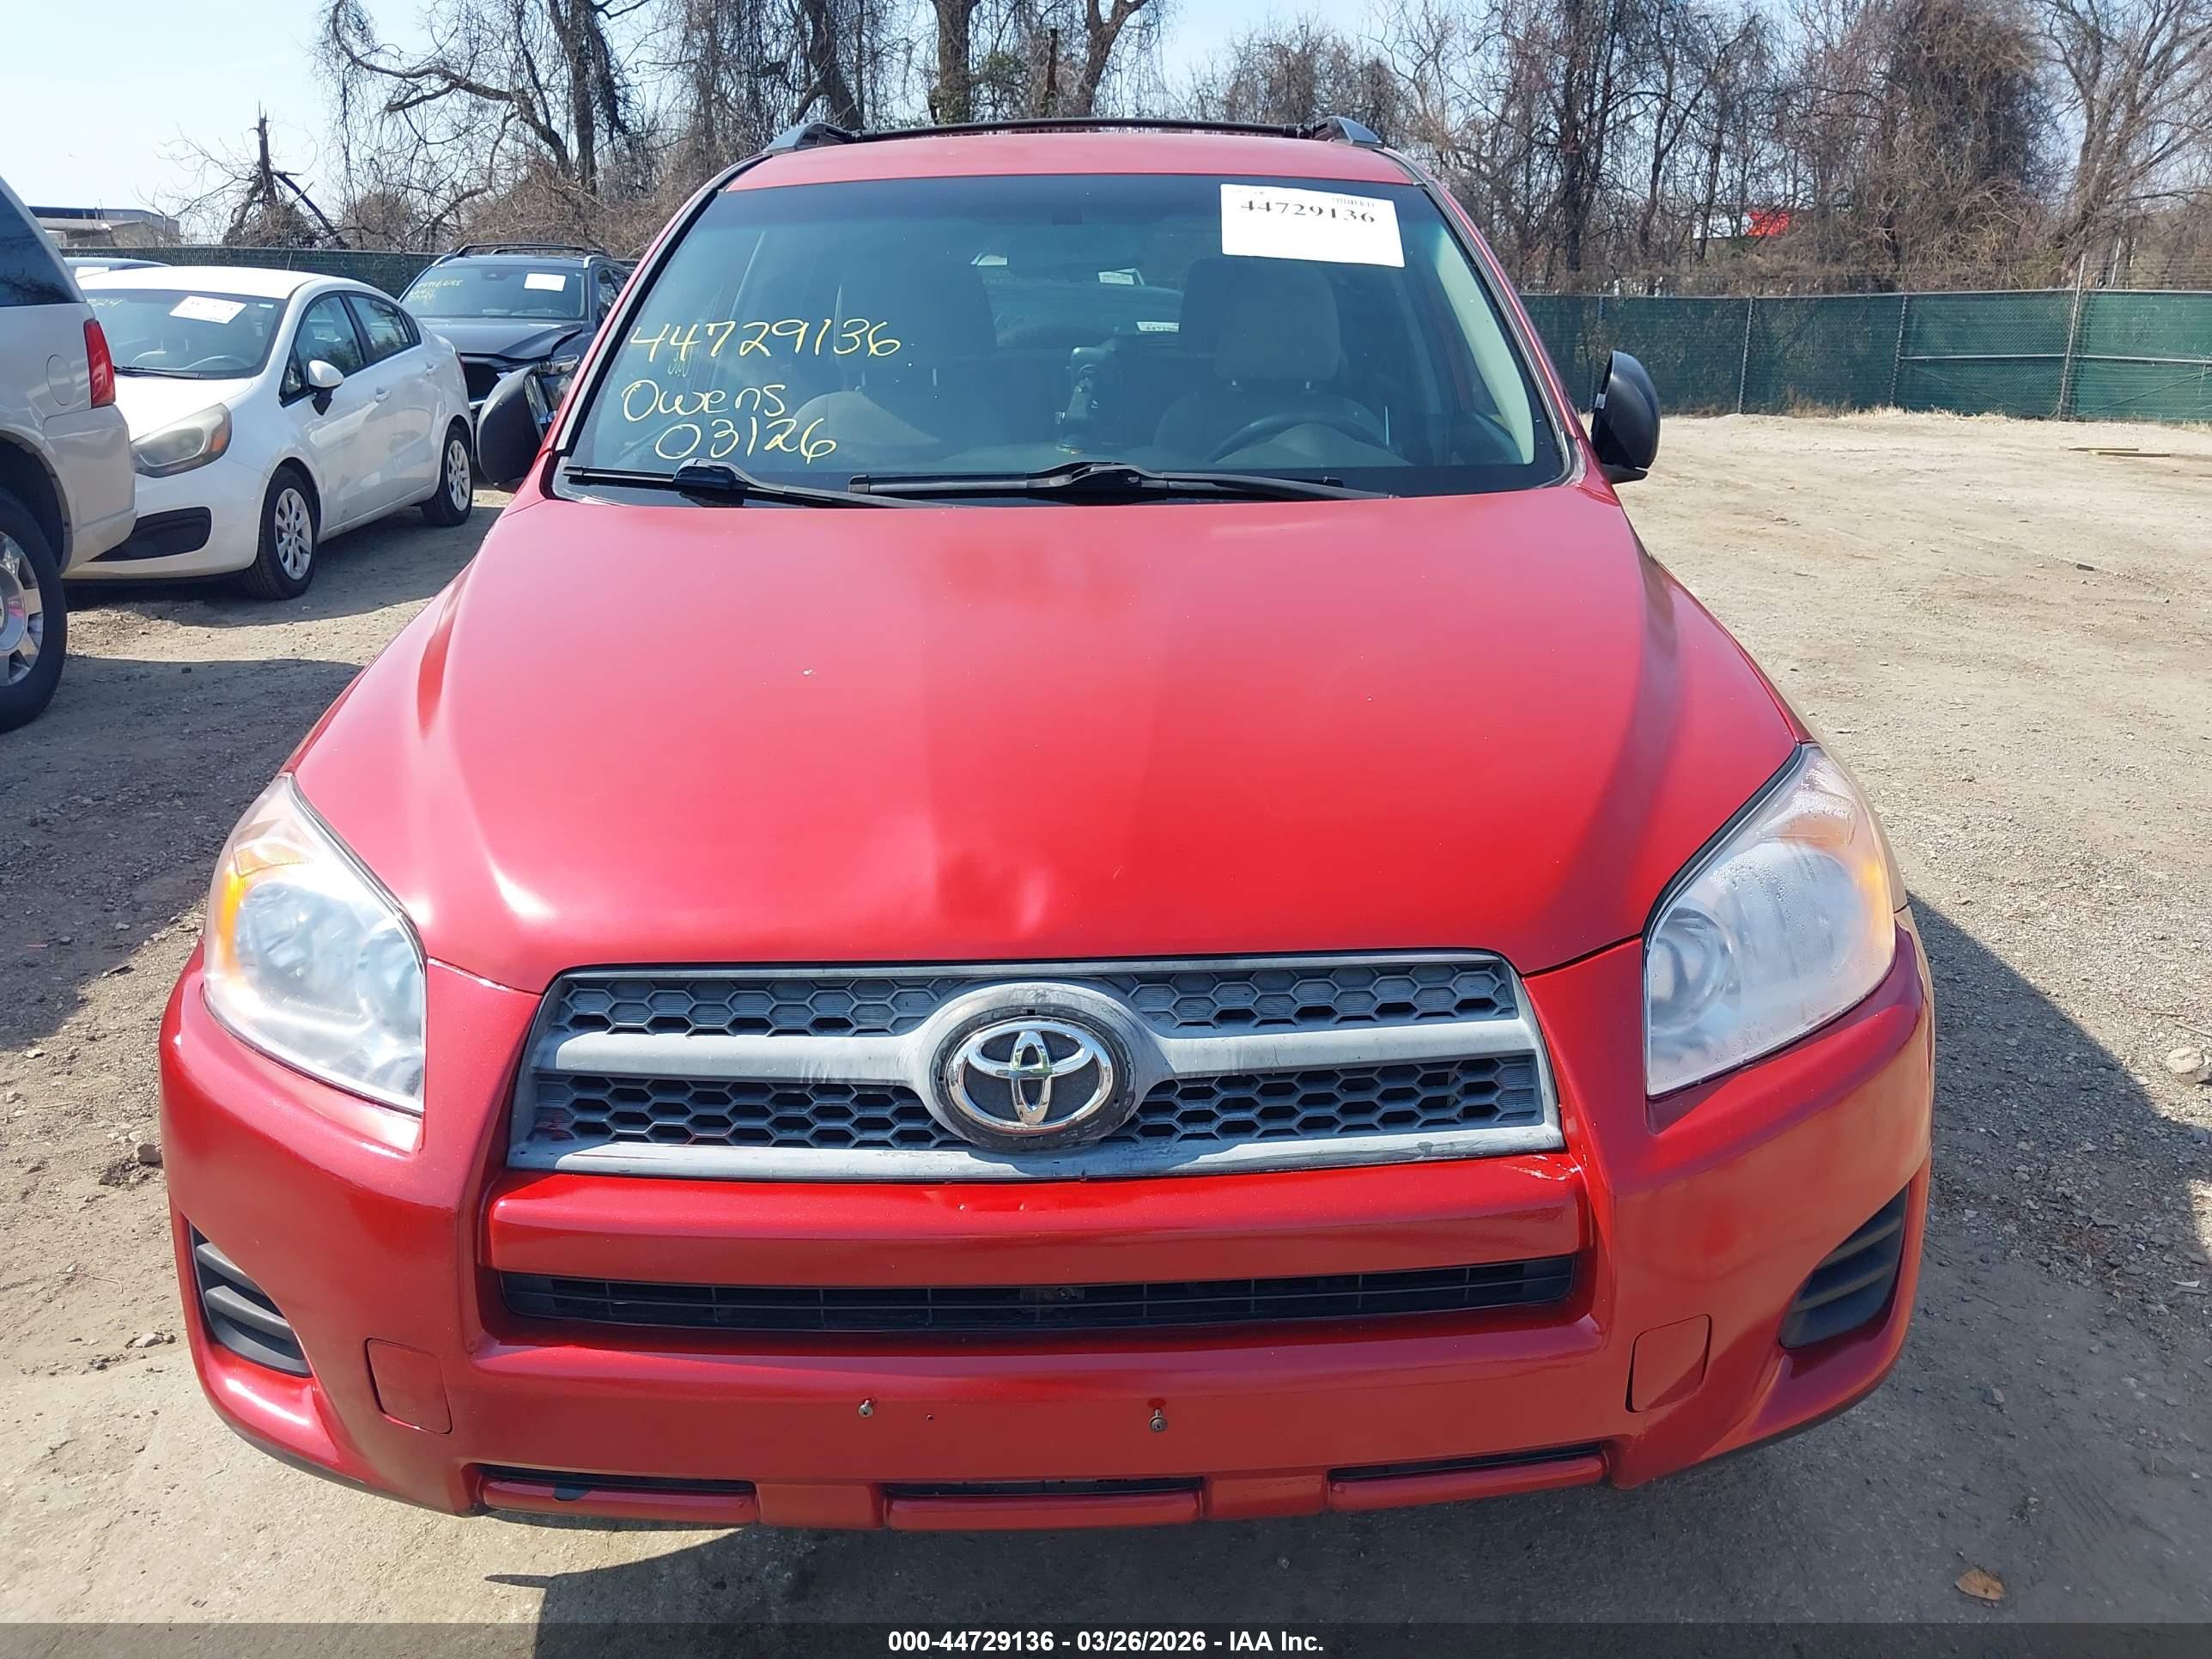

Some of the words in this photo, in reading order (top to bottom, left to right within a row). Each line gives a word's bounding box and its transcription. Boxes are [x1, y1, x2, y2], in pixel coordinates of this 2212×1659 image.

[1241, 199, 1375, 223] 44729136
[629, 317, 902, 363] 44729136
[621, 379, 787, 422] Owens
